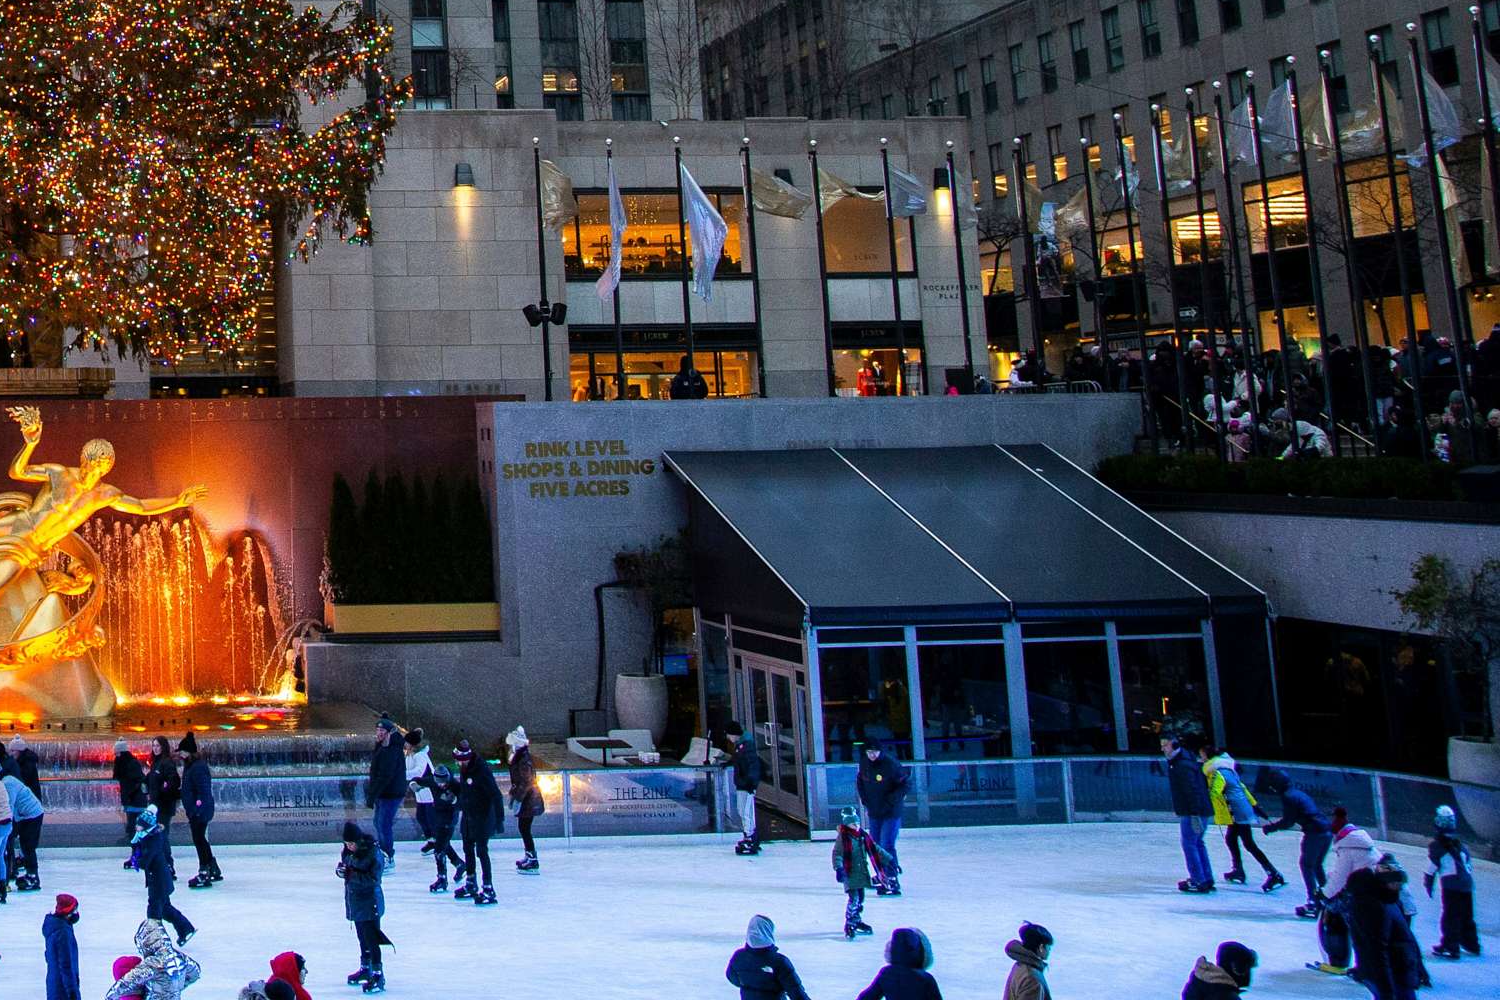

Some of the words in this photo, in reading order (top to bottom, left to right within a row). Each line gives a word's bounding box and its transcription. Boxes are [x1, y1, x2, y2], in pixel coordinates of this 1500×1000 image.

[524, 441, 570, 458] RINK
[575, 440, 629, 456] LEVEL
[502, 463, 564, 479] SHOPS
[568, 461, 582, 477] &
[587, 459, 655, 476] DINING
[530, 482, 570, 498] FIVE
[573, 480, 630, 496] ACRES
[266, 795, 290, 808] THE
[294, 794, 325, 808] RINK
[613, 787, 637, 800] THE
[642, 784, 672, 799] RINK
